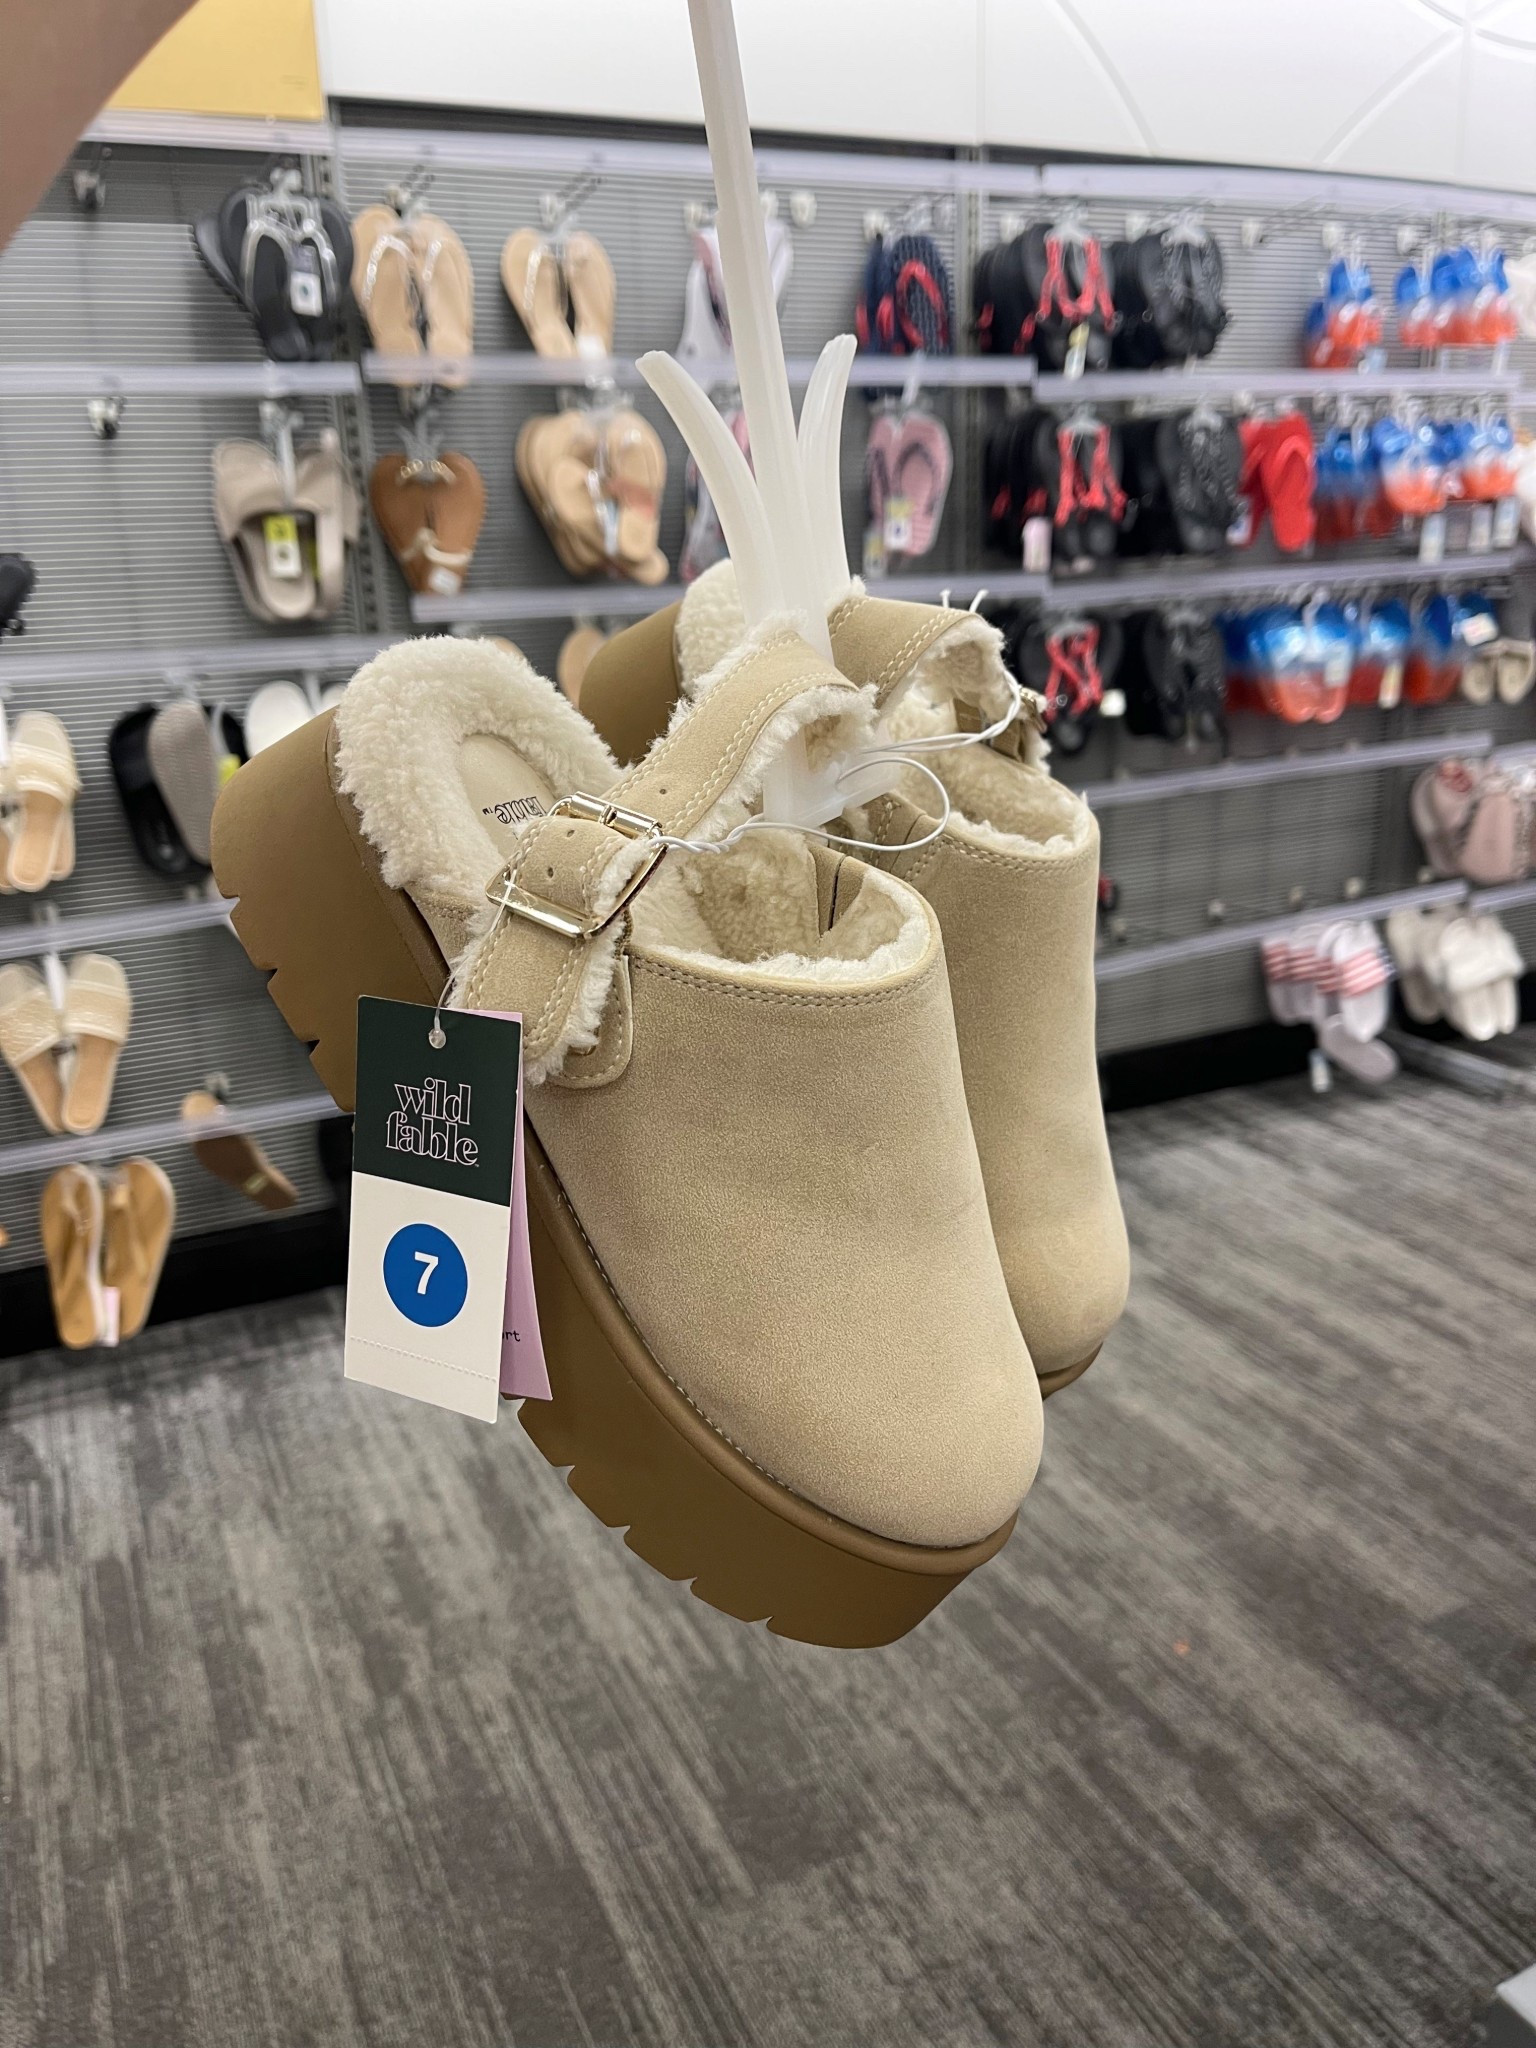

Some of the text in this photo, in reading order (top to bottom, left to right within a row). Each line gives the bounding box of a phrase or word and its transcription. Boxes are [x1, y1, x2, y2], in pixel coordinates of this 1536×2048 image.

[394, 1077, 471, 1125] wild
[386, 1110, 478, 1166] fable
[414, 1251, 439, 1295] 7
[502, 1329, 521, 1342] rt
